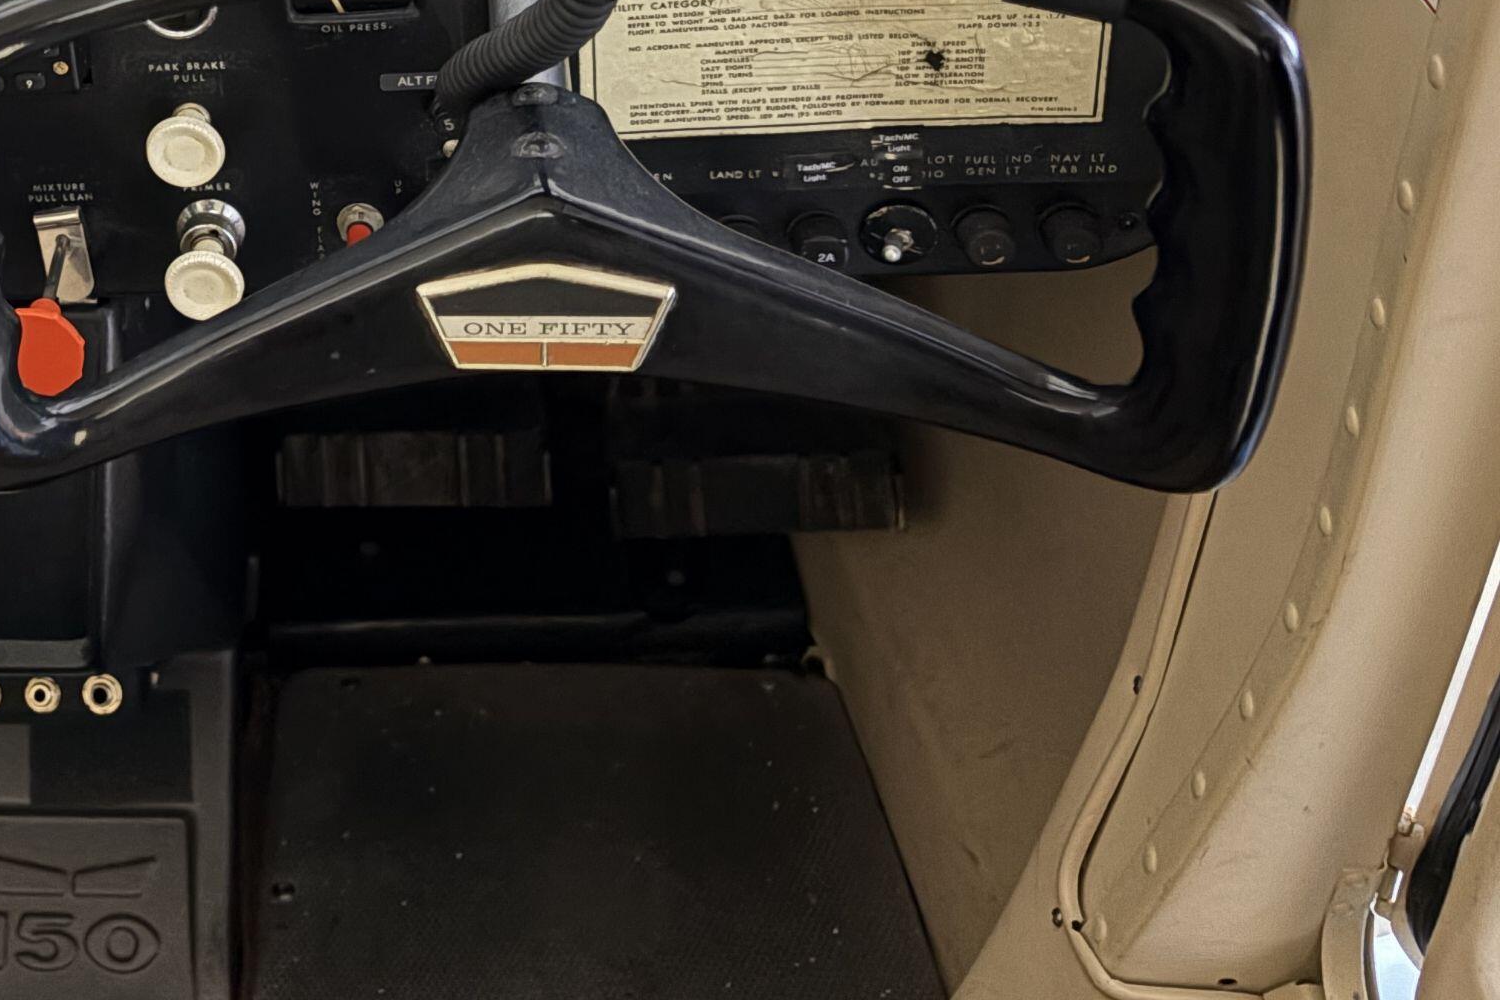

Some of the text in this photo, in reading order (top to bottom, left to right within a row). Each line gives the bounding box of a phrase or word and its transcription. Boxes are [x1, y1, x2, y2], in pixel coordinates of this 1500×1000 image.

[650, 0, 713, 10] CATEGORY
[821, 8, 925, 17] LOADING INSTRUCTIONS
[321, 21, 393, 34] OIL PRESS.
[147, 60, 227, 73] PARK BRAKE
[172, 73, 206, 83] PULL
[397, 75, 424, 87] ALT
[878, 132, 919, 143] Tach/MC
[887, 143, 912, 153] Light
[964, 153, 1033, 165] FUEL IND
[1050, 153, 1081, 164] NAV
[796, 161, 837, 172] Tach/MC
[892, 164, 908, 173] ON
[965, 166, 996, 176] GEN
[1088, 164, 1118, 174] IND
[709, 169, 743, 180] LAND
[802, 172, 827, 183] Light
[892, 174, 912, 184] OFF
[32, 182, 86, 193] MIXTURE
[27, 191, 94, 204] PULL LEAN
[817, 252, 836, 264] 2A
[463, 321, 635, 336] ONE FIFTY
